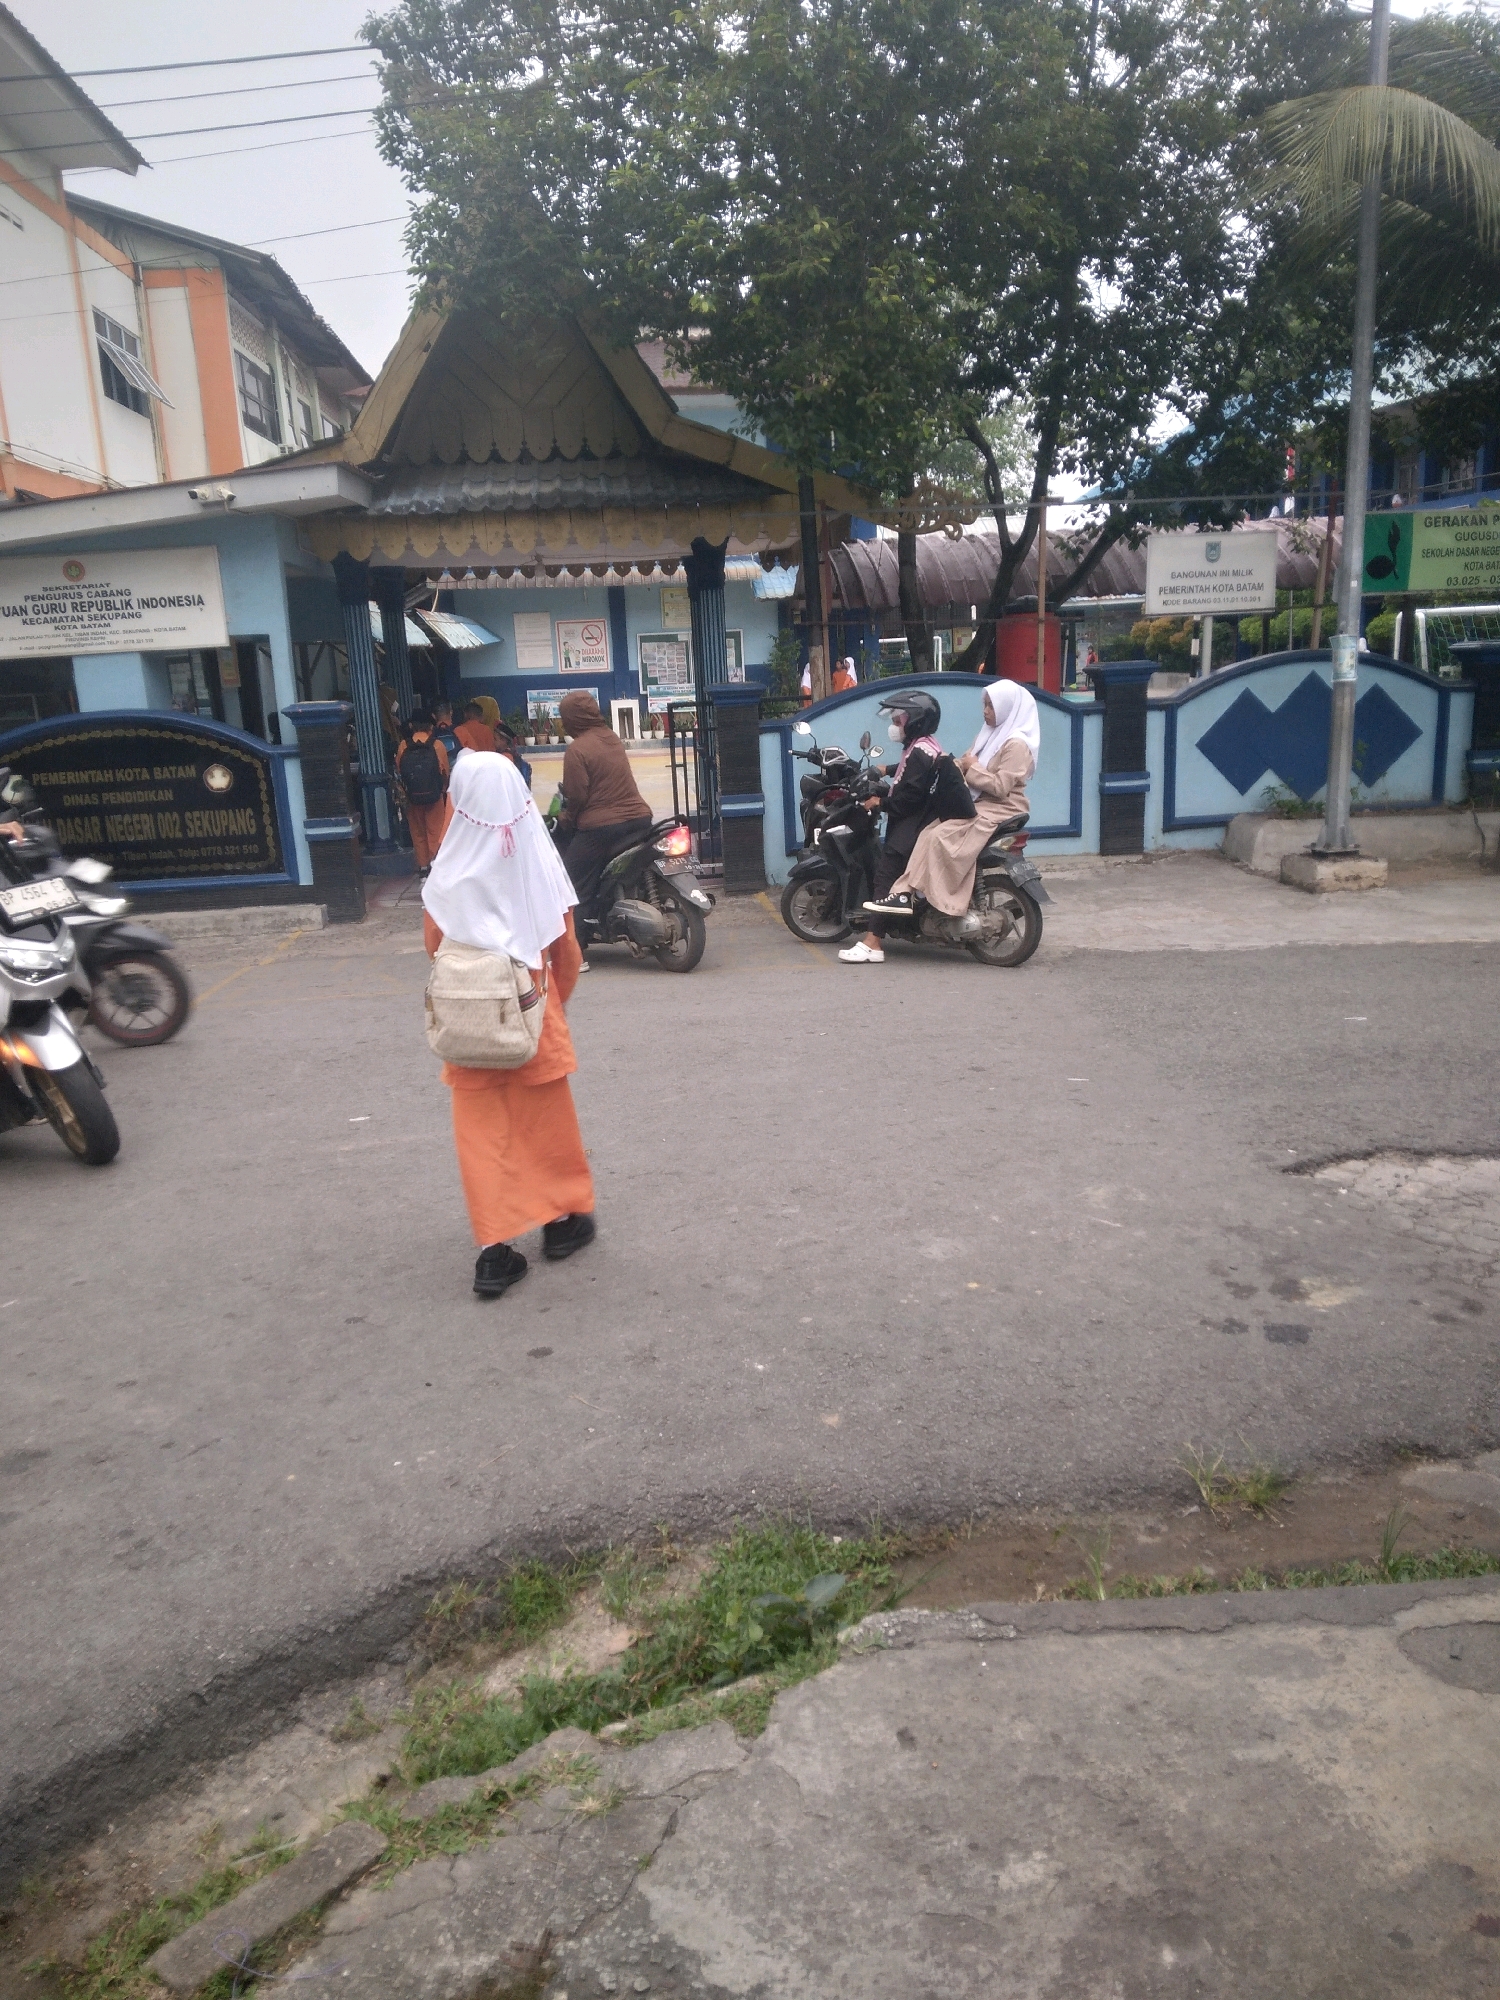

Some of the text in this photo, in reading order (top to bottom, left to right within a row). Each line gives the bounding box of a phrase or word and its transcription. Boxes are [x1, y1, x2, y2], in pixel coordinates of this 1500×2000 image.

[1424, 514, 1488, 528] GERAKAN
[1421, 548, 1455, 558] SEKOLAH
[1456, 547, 1480, 557] DASAR
[1464, 560, 1500, 571] KOTA BAT
[1170, 568, 1253, 579] BANGUNAN INI MILIK
[42, 583, 111, 592] SEKRETARIAT
[1158, 582, 1264, 596] PEMERINTAH KOTA BATAM
[24, 588, 132, 602] PENGURUS CABANG
[1182, 597, 1212, 605] BARANG
[0, 594, 205, 617] UAN GURU REPUBLIK INDONESIA
[22, 612, 142, 625] KECAMATAN SEKUPANG
[81, 622, 111, 630] BATAM
[32, 765, 197, 785] PEMERINTAH KOTA BATAM
[63, 789, 174, 806] DINAS PENDIDIKAN
[56, 815, 102, 844] DASAR
[104, 813, 156, 842] NEGERI
[157, 811, 183, 839] 002
[184, 807, 257, 838] SEKUPANG
[0, 892, 14, 905] BP
[20, 884, 48, 900] 4564
